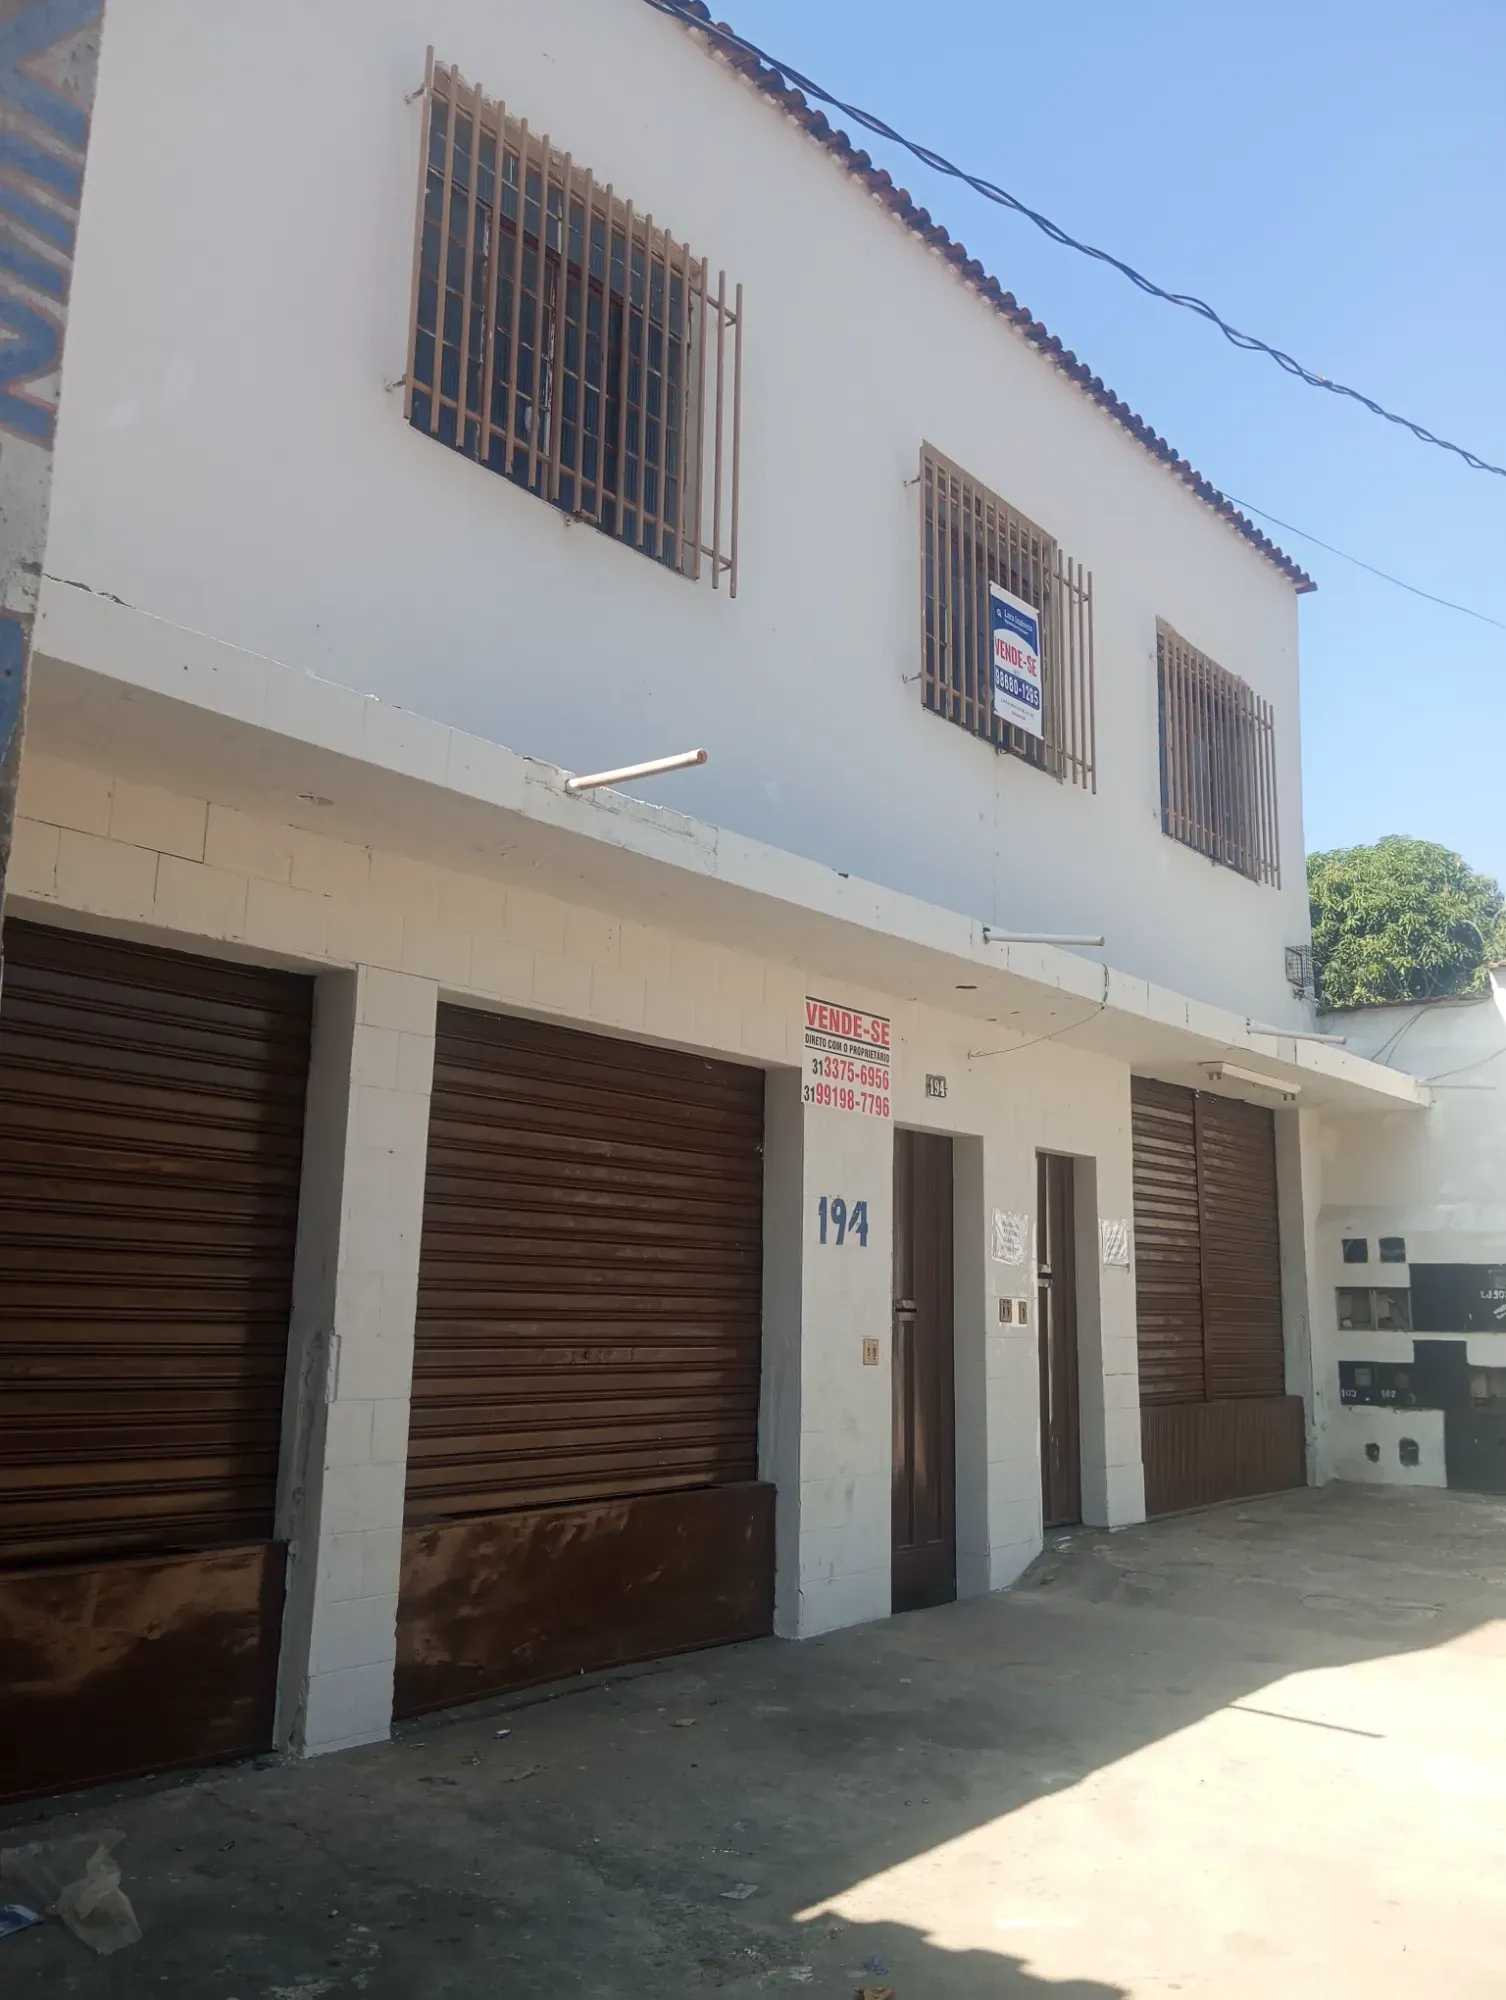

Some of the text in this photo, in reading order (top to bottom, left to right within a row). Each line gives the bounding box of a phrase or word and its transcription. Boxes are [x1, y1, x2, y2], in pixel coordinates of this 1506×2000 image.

[994, 636, 1038, 678] VENDE-SE
[805, 1001, 890, 1046] VENDE-SE
[805, 1033, 890, 1063] DIRETO COM O PROPRIETÁRIO
[928, 1078, 946, 1097] 194
[818, 1195, 869, 1248] 194
